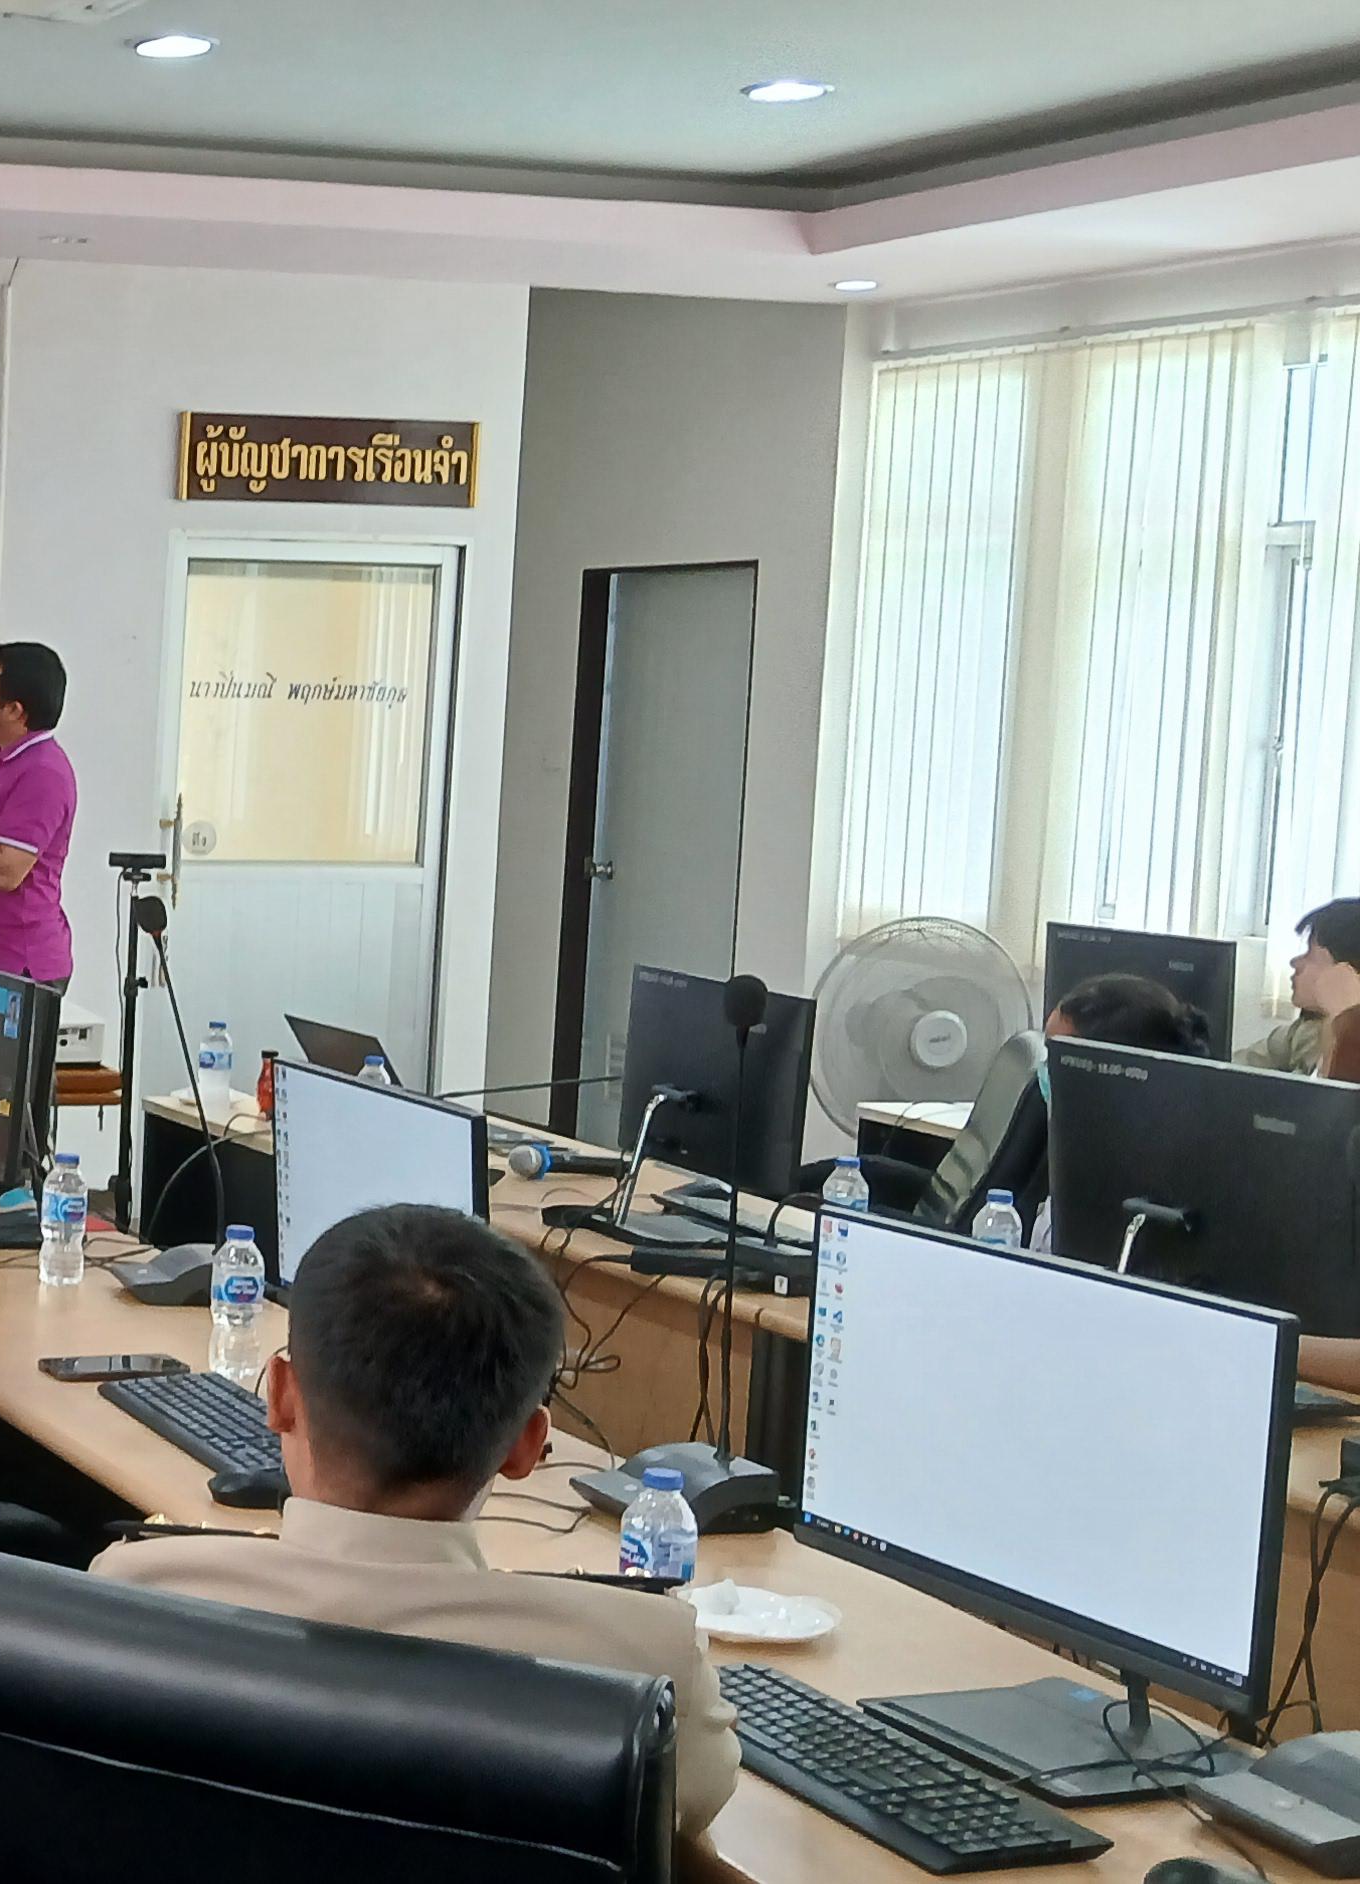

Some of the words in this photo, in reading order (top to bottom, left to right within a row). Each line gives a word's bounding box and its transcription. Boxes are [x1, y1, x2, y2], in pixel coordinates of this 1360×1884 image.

[196, 425, 469, 493] ผู้บัญชาการเรือนจำ
